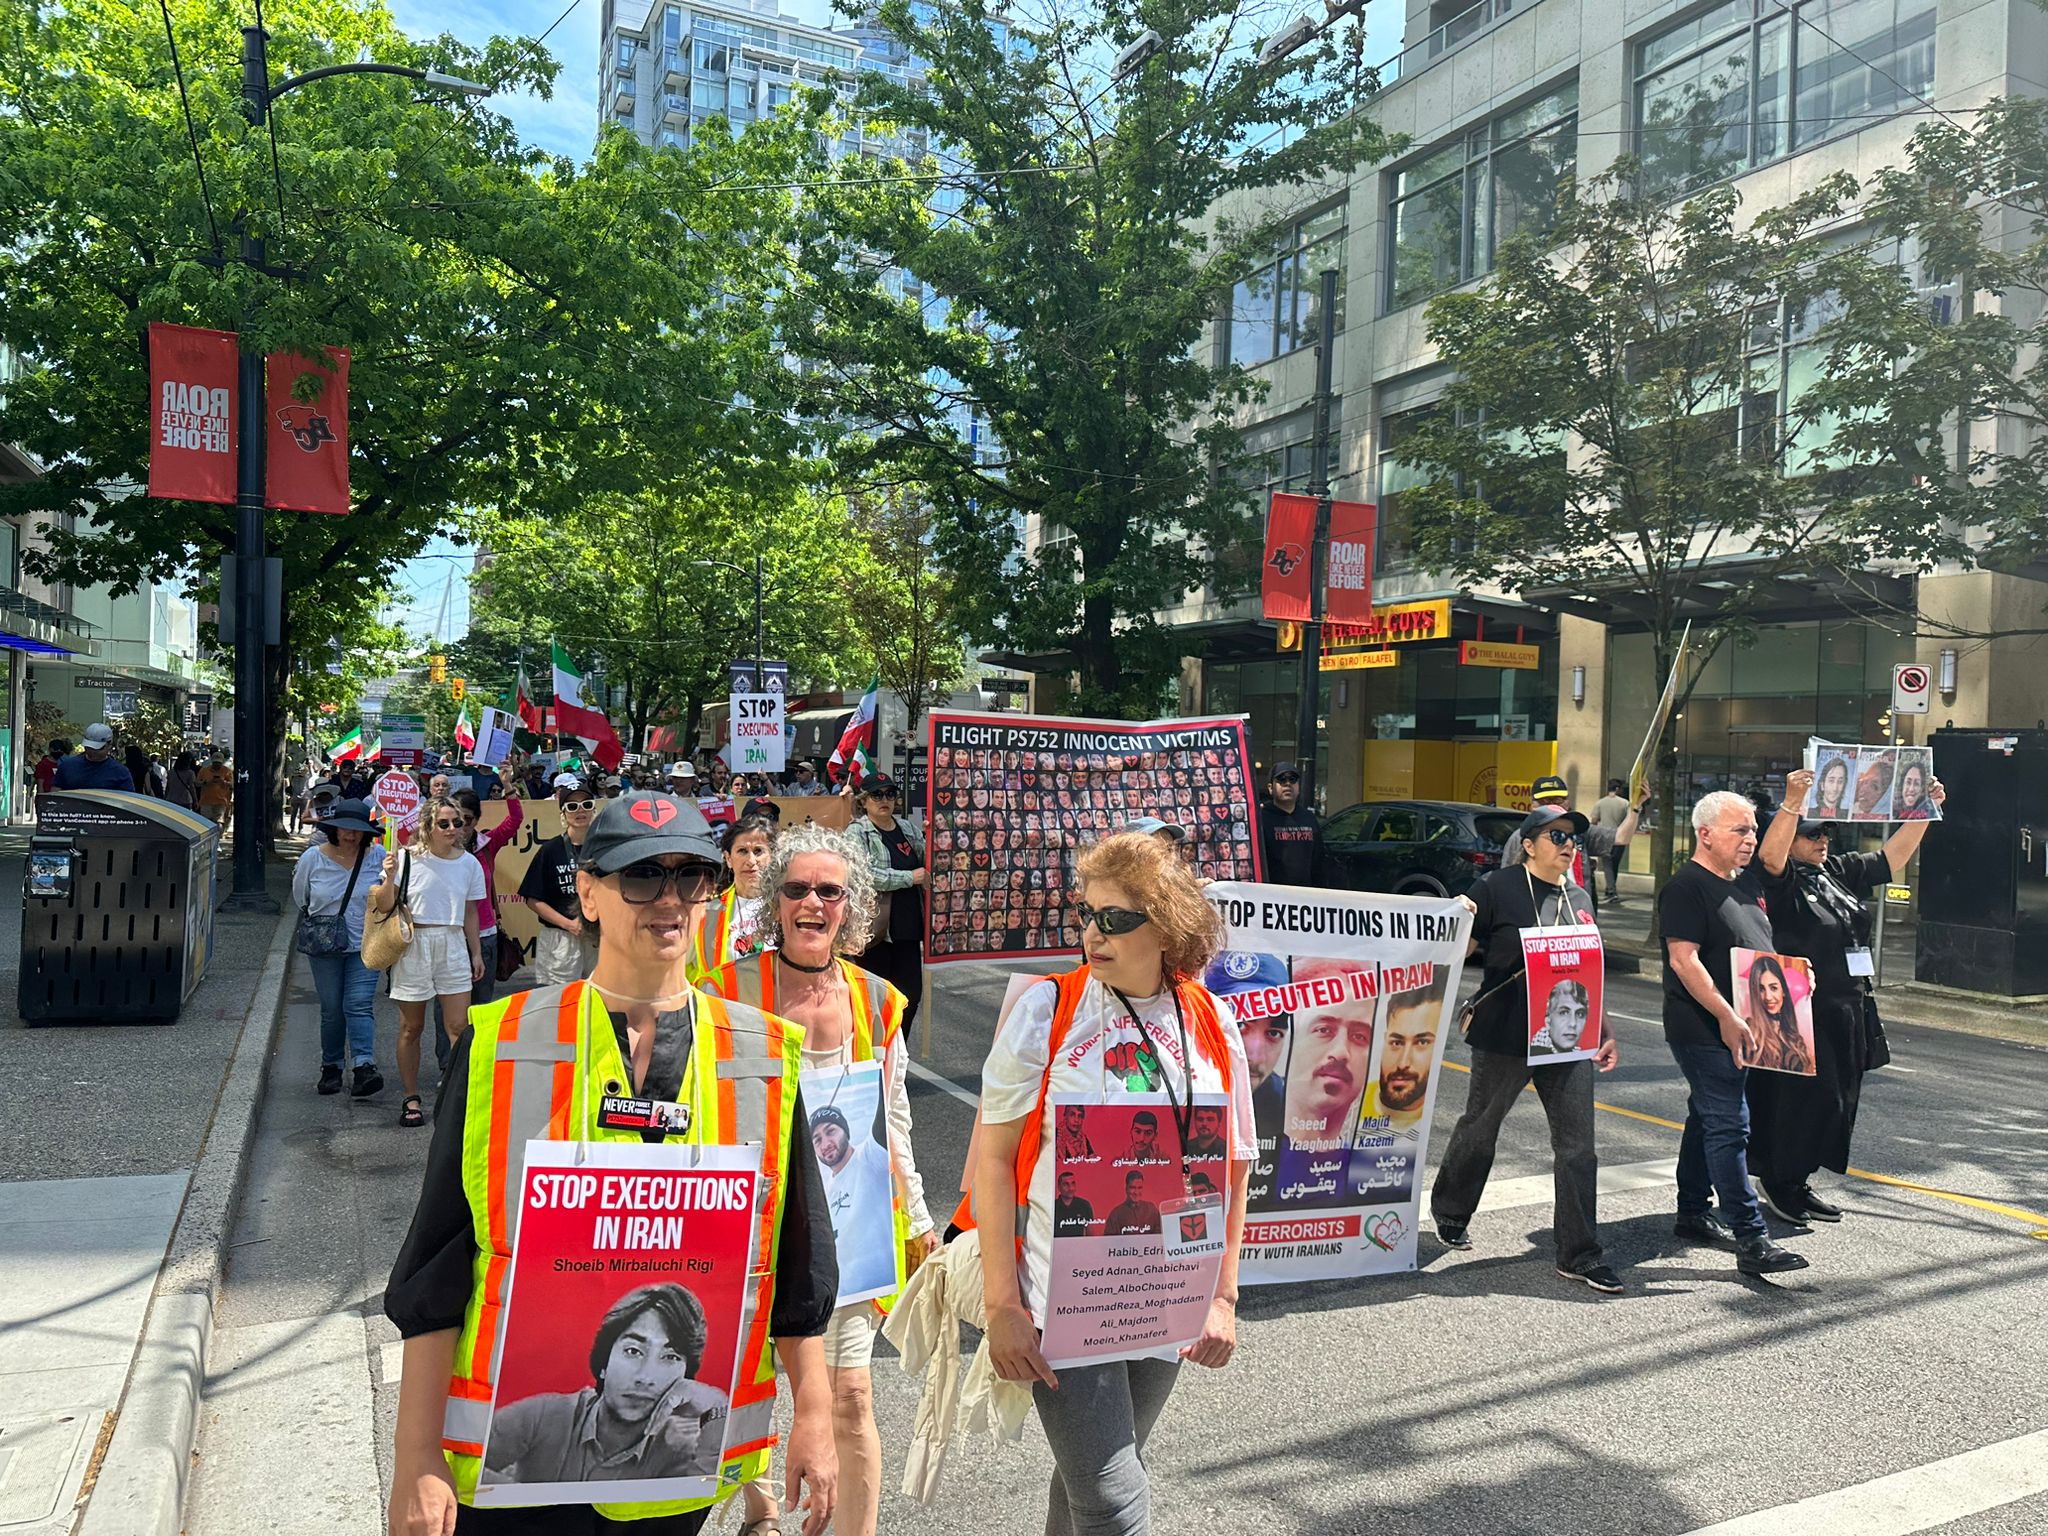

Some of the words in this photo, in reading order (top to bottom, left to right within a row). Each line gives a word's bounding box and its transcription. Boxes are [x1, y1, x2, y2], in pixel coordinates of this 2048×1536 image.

[1330, 541, 1366, 564] ROAR
[1330, 563, 1344, 574] LIKE
[1344, 563, 1366, 575] NEVER
[1329, 574, 1365, 590] BEFORE
[1388, 610, 1435, 632] GUYS
[1340, 657, 1359, 666] GYRO
[1363, 653, 1393, 664] FALAFEL
[739, 699, 776, 718] STOP
[941, 726, 1002, 746] FLIGHT
[1007, 729, 1058, 748] PS752
[1063, 732, 1152, 750] INNOCENT
[1156, 729, 1232, 749] VICTIMS
[745, 748, 768, 764] IRAN
[383, 778, 414, 792] STOP
[379, 788, 418, 800] EXECUTIONS
[386, 803, 408, 814] IRAN
[1207, 898, 1256, 928] TOP
[1262, 902, 1383, 938] EXECUTIONS
[1390, 912, 1409, 940] IN
[1416, 914, 1460, 942] IRAN
[1526, 938, 1548, 953] STOP
[1548, 935, 1600, 952] EXECUTIONS
[1549, 952, 1560, 967] IN
[1560, 951, 1580, 966] IRAN
[1222, 976, 1345, 1022] XECUTED
[1349, 968, 1378, 1002] IN
[1382, 960, 1434, 995] IRAN
[604, 1098, 636, 1114] NEVER
[1291, 1116, 1327, 1130] Saeed
[1362, 1115, 1390, 1131] Majid
[1358, 1136, 1394, 1148] Kazemi
[1310, 1162, 1342, 1177] سعید
[1376, 1154, 1406, 1170] مجید
[530, 1174, 598, 1209] STOP
[601, 1176, 749, 1211] EXECUTIONS
[592, 1216, 620, 1250] IN
[624, 1216, 684, 1250] IRAN
[1108, 1246, 1164, 1258] Habib_Edri
[1168, 1242, 1224, 1258] VOLUNTEER
[1264, 1244, 1294, 1260] WUTH
[1296, 1242, 1342, 1257] IRANIANS
[553, 1258, 604, 1272] Shoeib
[608, 1258, 682, 1272] Mirbaluchi
[686, 1260, 714, 1274] Rigi
[1072, 1267, 1104, 1279] Seyed
[1106, 1262, 1200, 1276] Adnan_Ghabichavi
[1082, 1280, 1186, 1296] Salem_AlboChouqué
[1056, 1294, 1204, 1315] MohammadReza_Moghaddam
[1100, 1315, 1158, 1329] Ali_Majdom
[1084, 1329, 1168, 1346] Moein_Khanaferé
